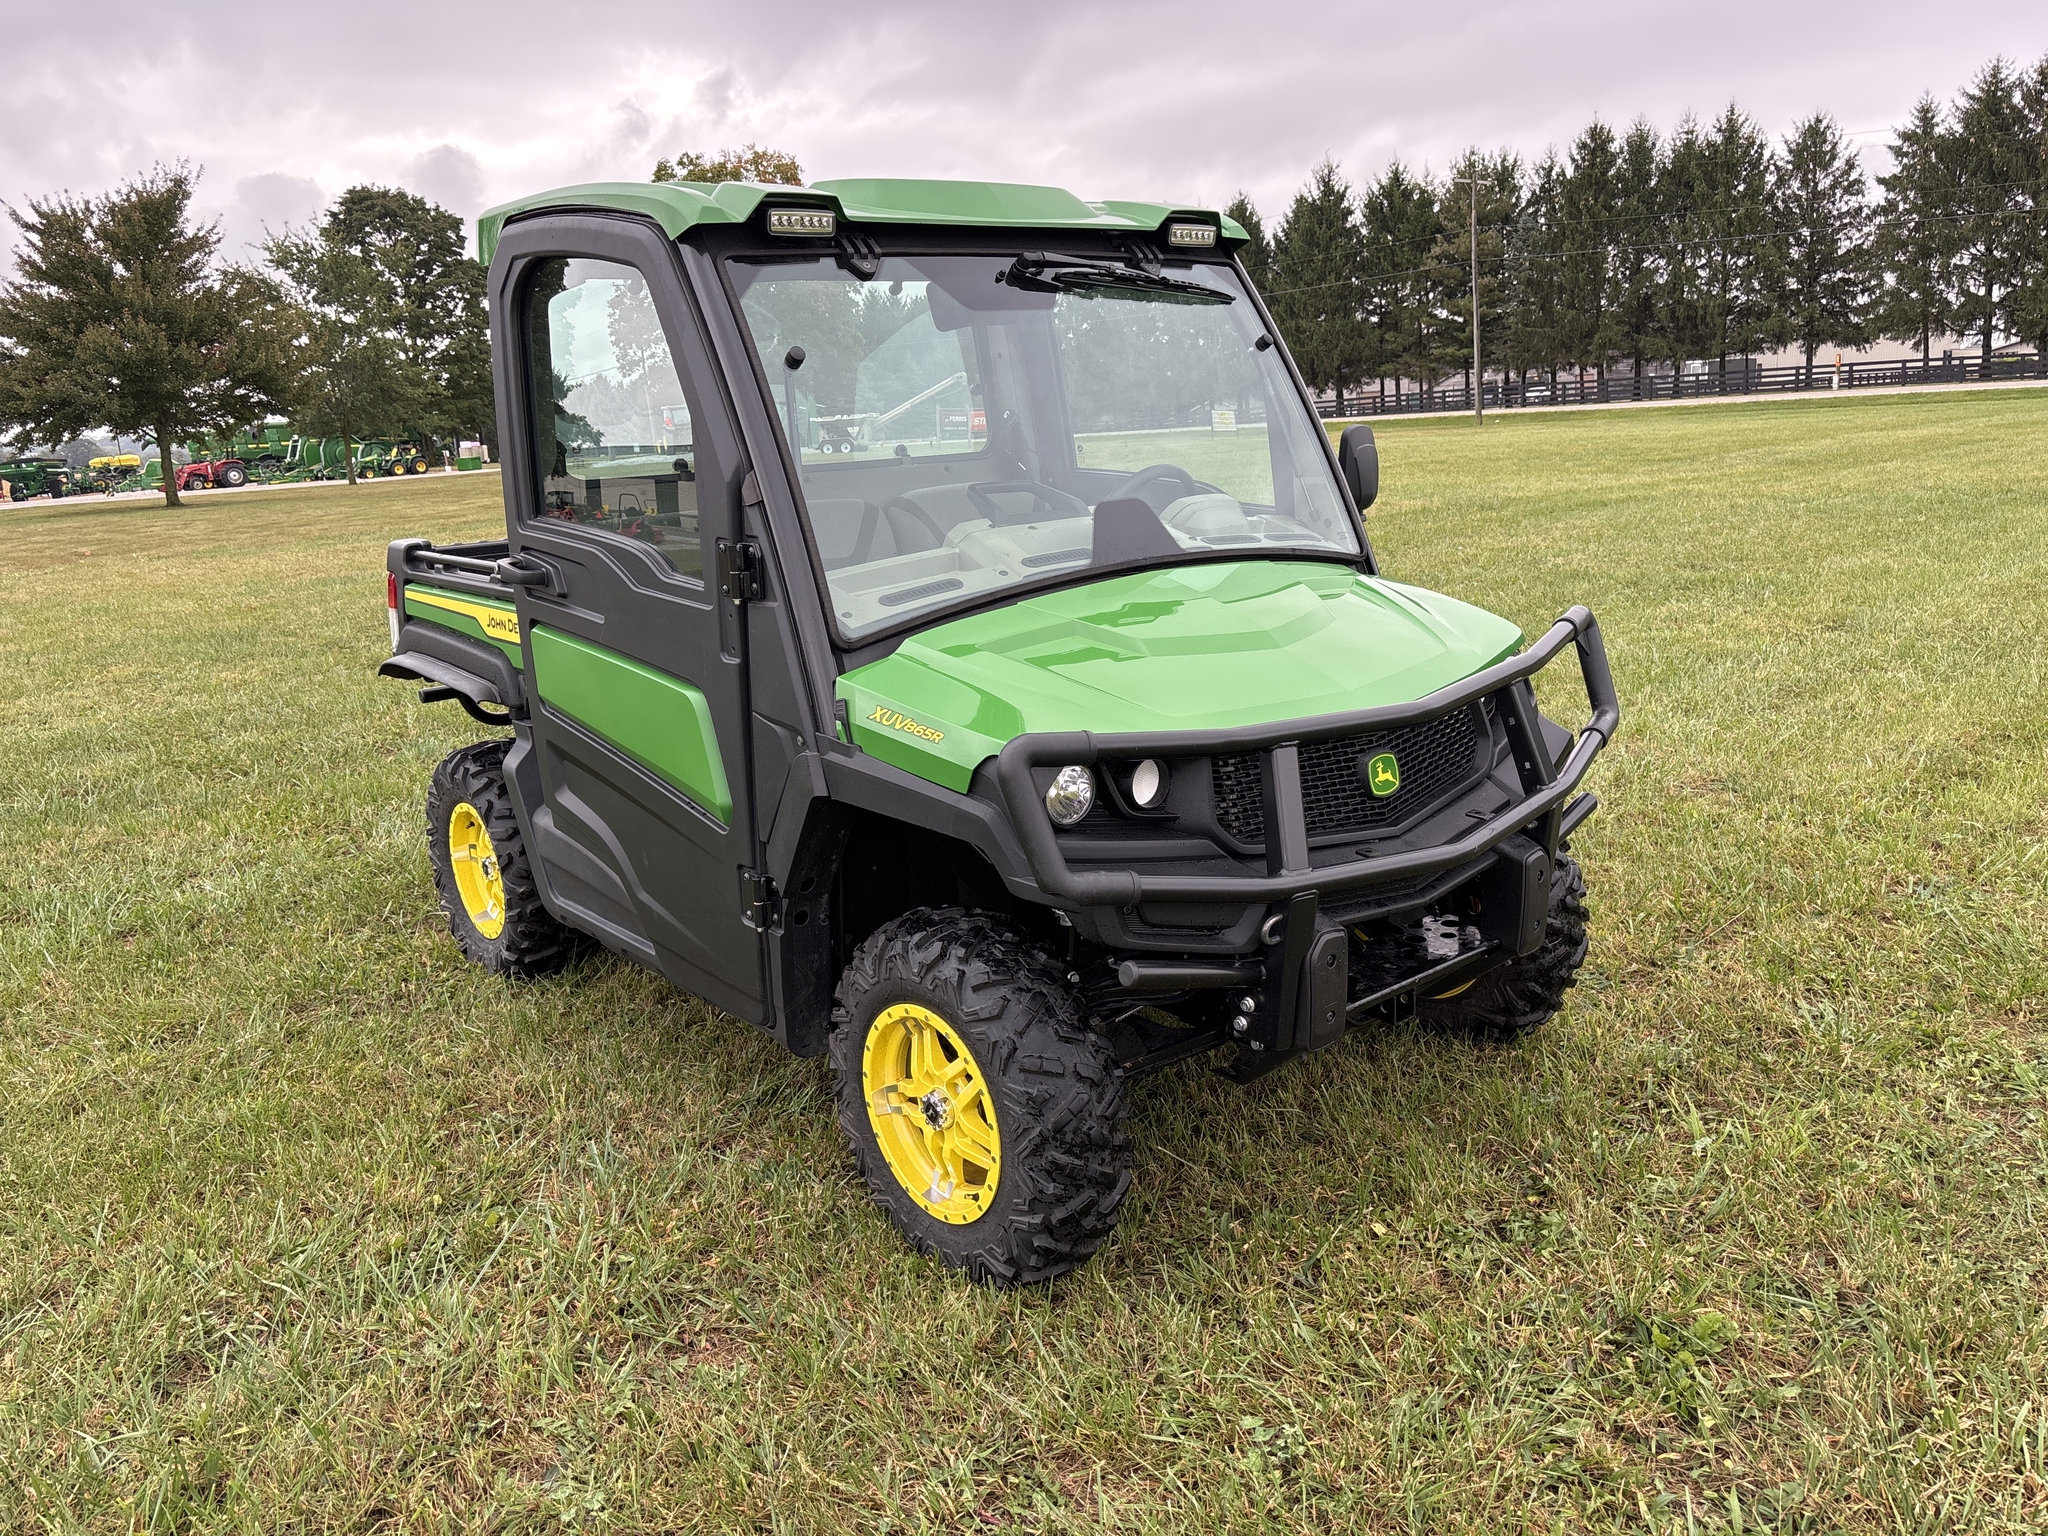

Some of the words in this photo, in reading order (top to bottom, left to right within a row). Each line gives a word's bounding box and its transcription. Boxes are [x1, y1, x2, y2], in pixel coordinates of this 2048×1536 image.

[973, 416, 987, 426] STI
[487, 614, 507, 632] JOHN
[866, 705, 945, 744] XUV865R
